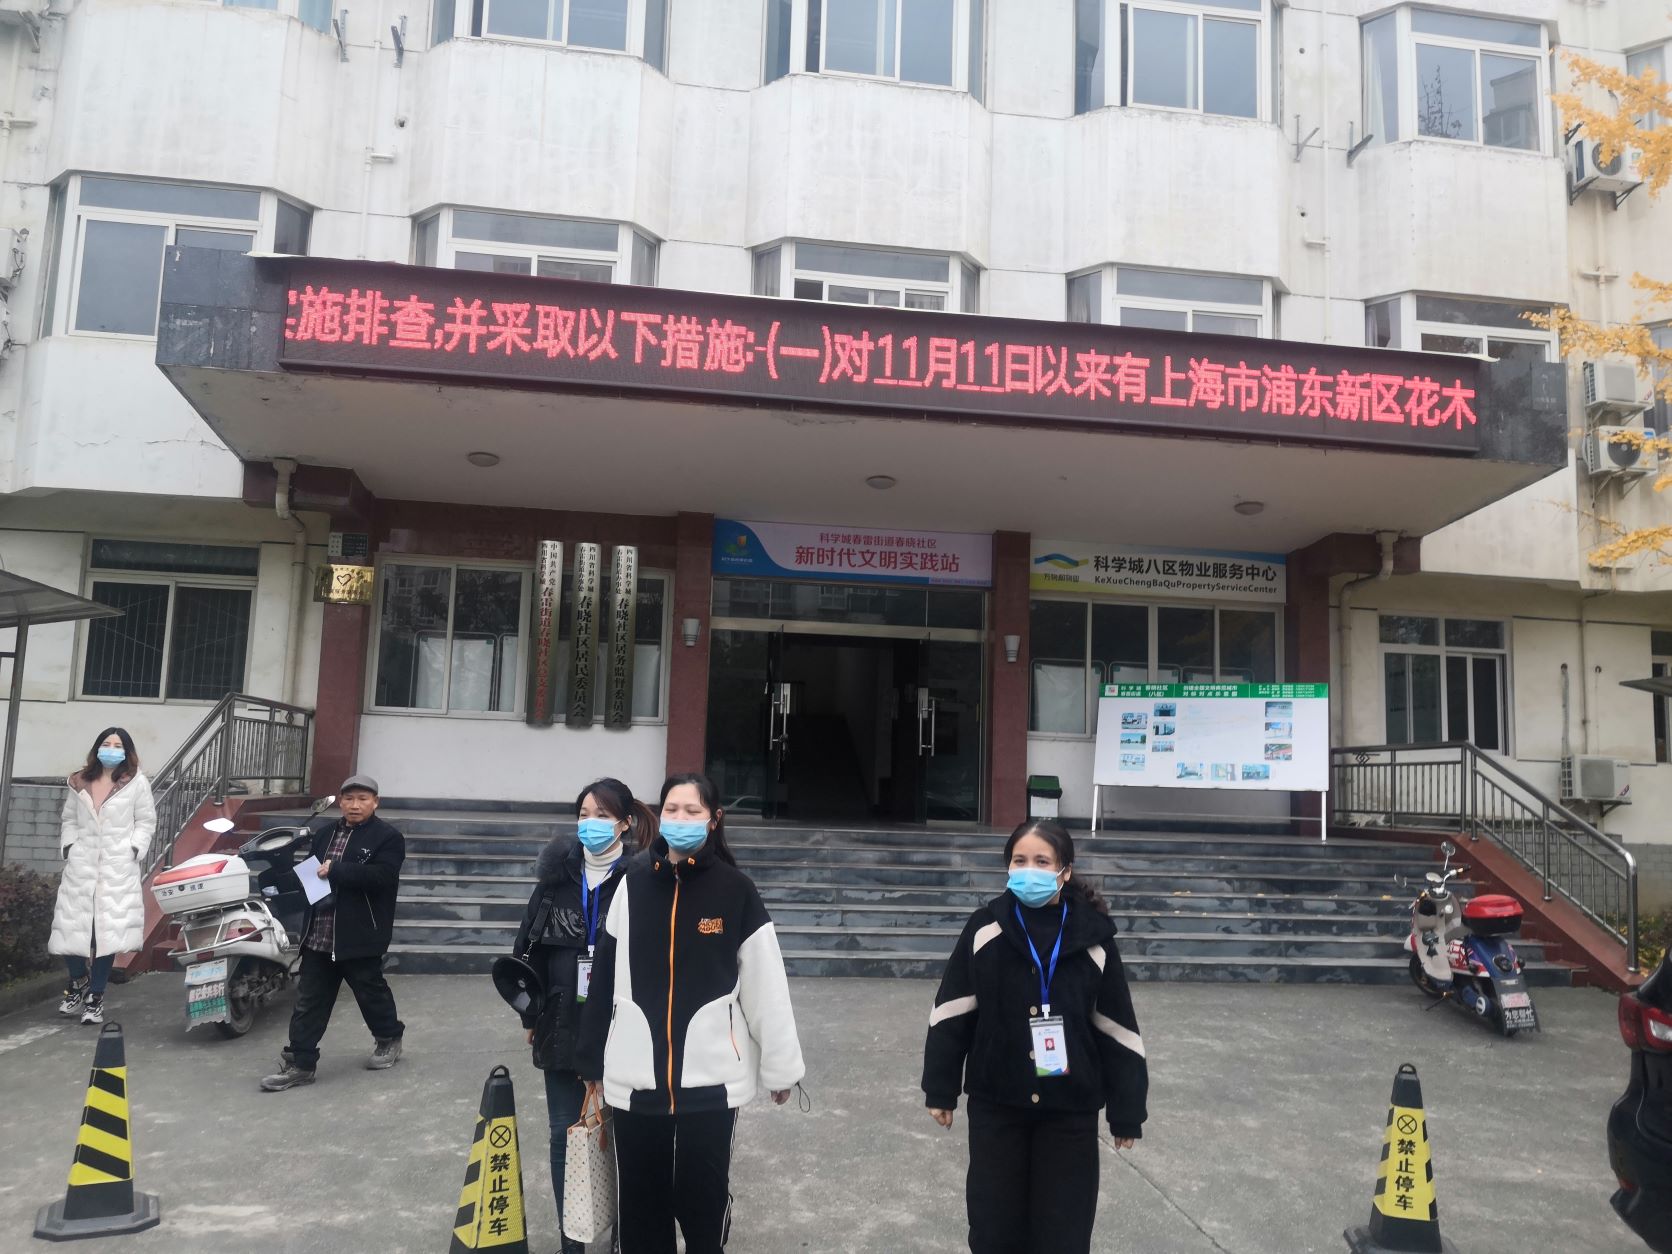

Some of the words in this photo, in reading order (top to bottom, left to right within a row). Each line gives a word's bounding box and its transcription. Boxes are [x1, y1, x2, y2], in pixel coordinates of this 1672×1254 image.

[819, 532, 937, 549] 科学城春雷街道春晓社区
[794, 545, 960, 573] 新时代文明实践站
[1093, 555, 1277, 582] 科学城八区物业服务中心
[1094, 575, 1278, 594] KeXueChengBaQuPropertyServiceCenter
[573, 596, 592, 717] 春晓社区居民委员会
[1395, 1138, 1416, 1211] 禁止停车
[487, 1152, 511, 1237] 禁止停车
